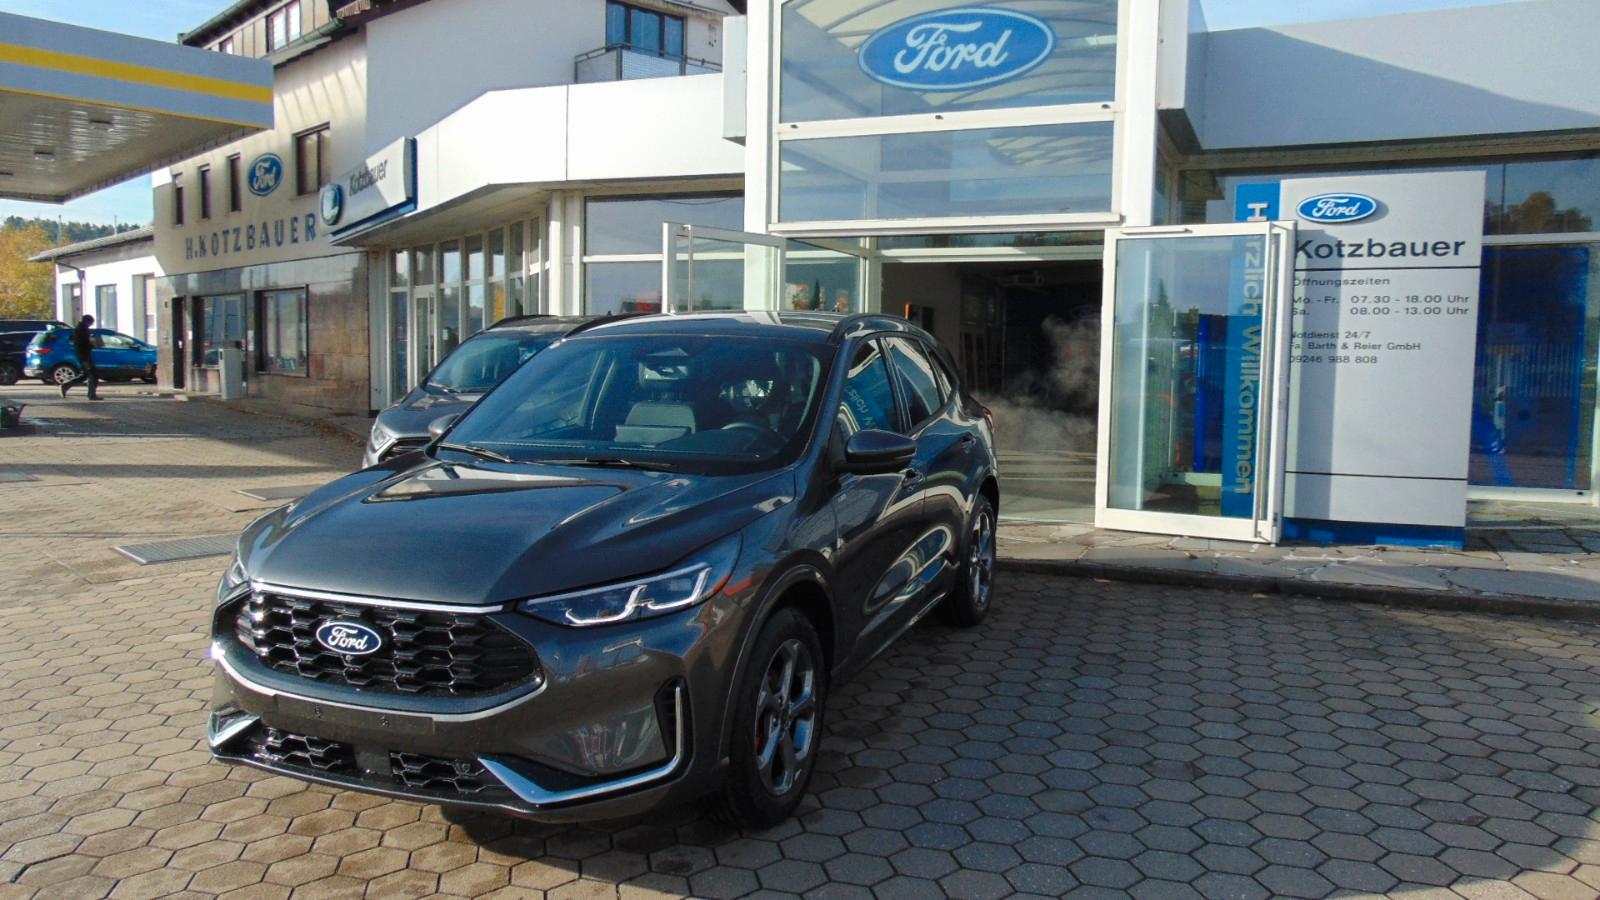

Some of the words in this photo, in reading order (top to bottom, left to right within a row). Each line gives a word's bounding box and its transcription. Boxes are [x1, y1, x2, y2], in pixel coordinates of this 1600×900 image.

[894, 21, 1012, 74] Ford
[253, 161, 276, 190] Ford
[349, 159, 388, 196] Kotzbauer
[1312, 197, 1360, 218] Ford
[1296, 238, 1466, 259] Kotzbauer
[1241, 203, 1269, 316] Hrzlich
[1324, 295, 1340, 304] Fr.
[1350, 295, 1391, 304] 07.30
[1405, 295, 1442, 304] 18.00
[1447, 295, 1470, 304] Uhr
[1350, 307, 1390, 316] 08.00
[1404, 307, 1442, 316] 13.00
[1446, 307, 1470, 316] Uhr
[1344, 331, 1372, 340] 24/7
[1307, 342, 1337, 350] Barth
[1340, 342, 1349, 350] &
[1353, 342, 1382, 350] Reier
[1386, 342, 1422, 351] GmbH
[1327, 355, 1350, 364] 988
[1354, 355, 1378, 364] 808
[327, 626, 369, 650] Ford
